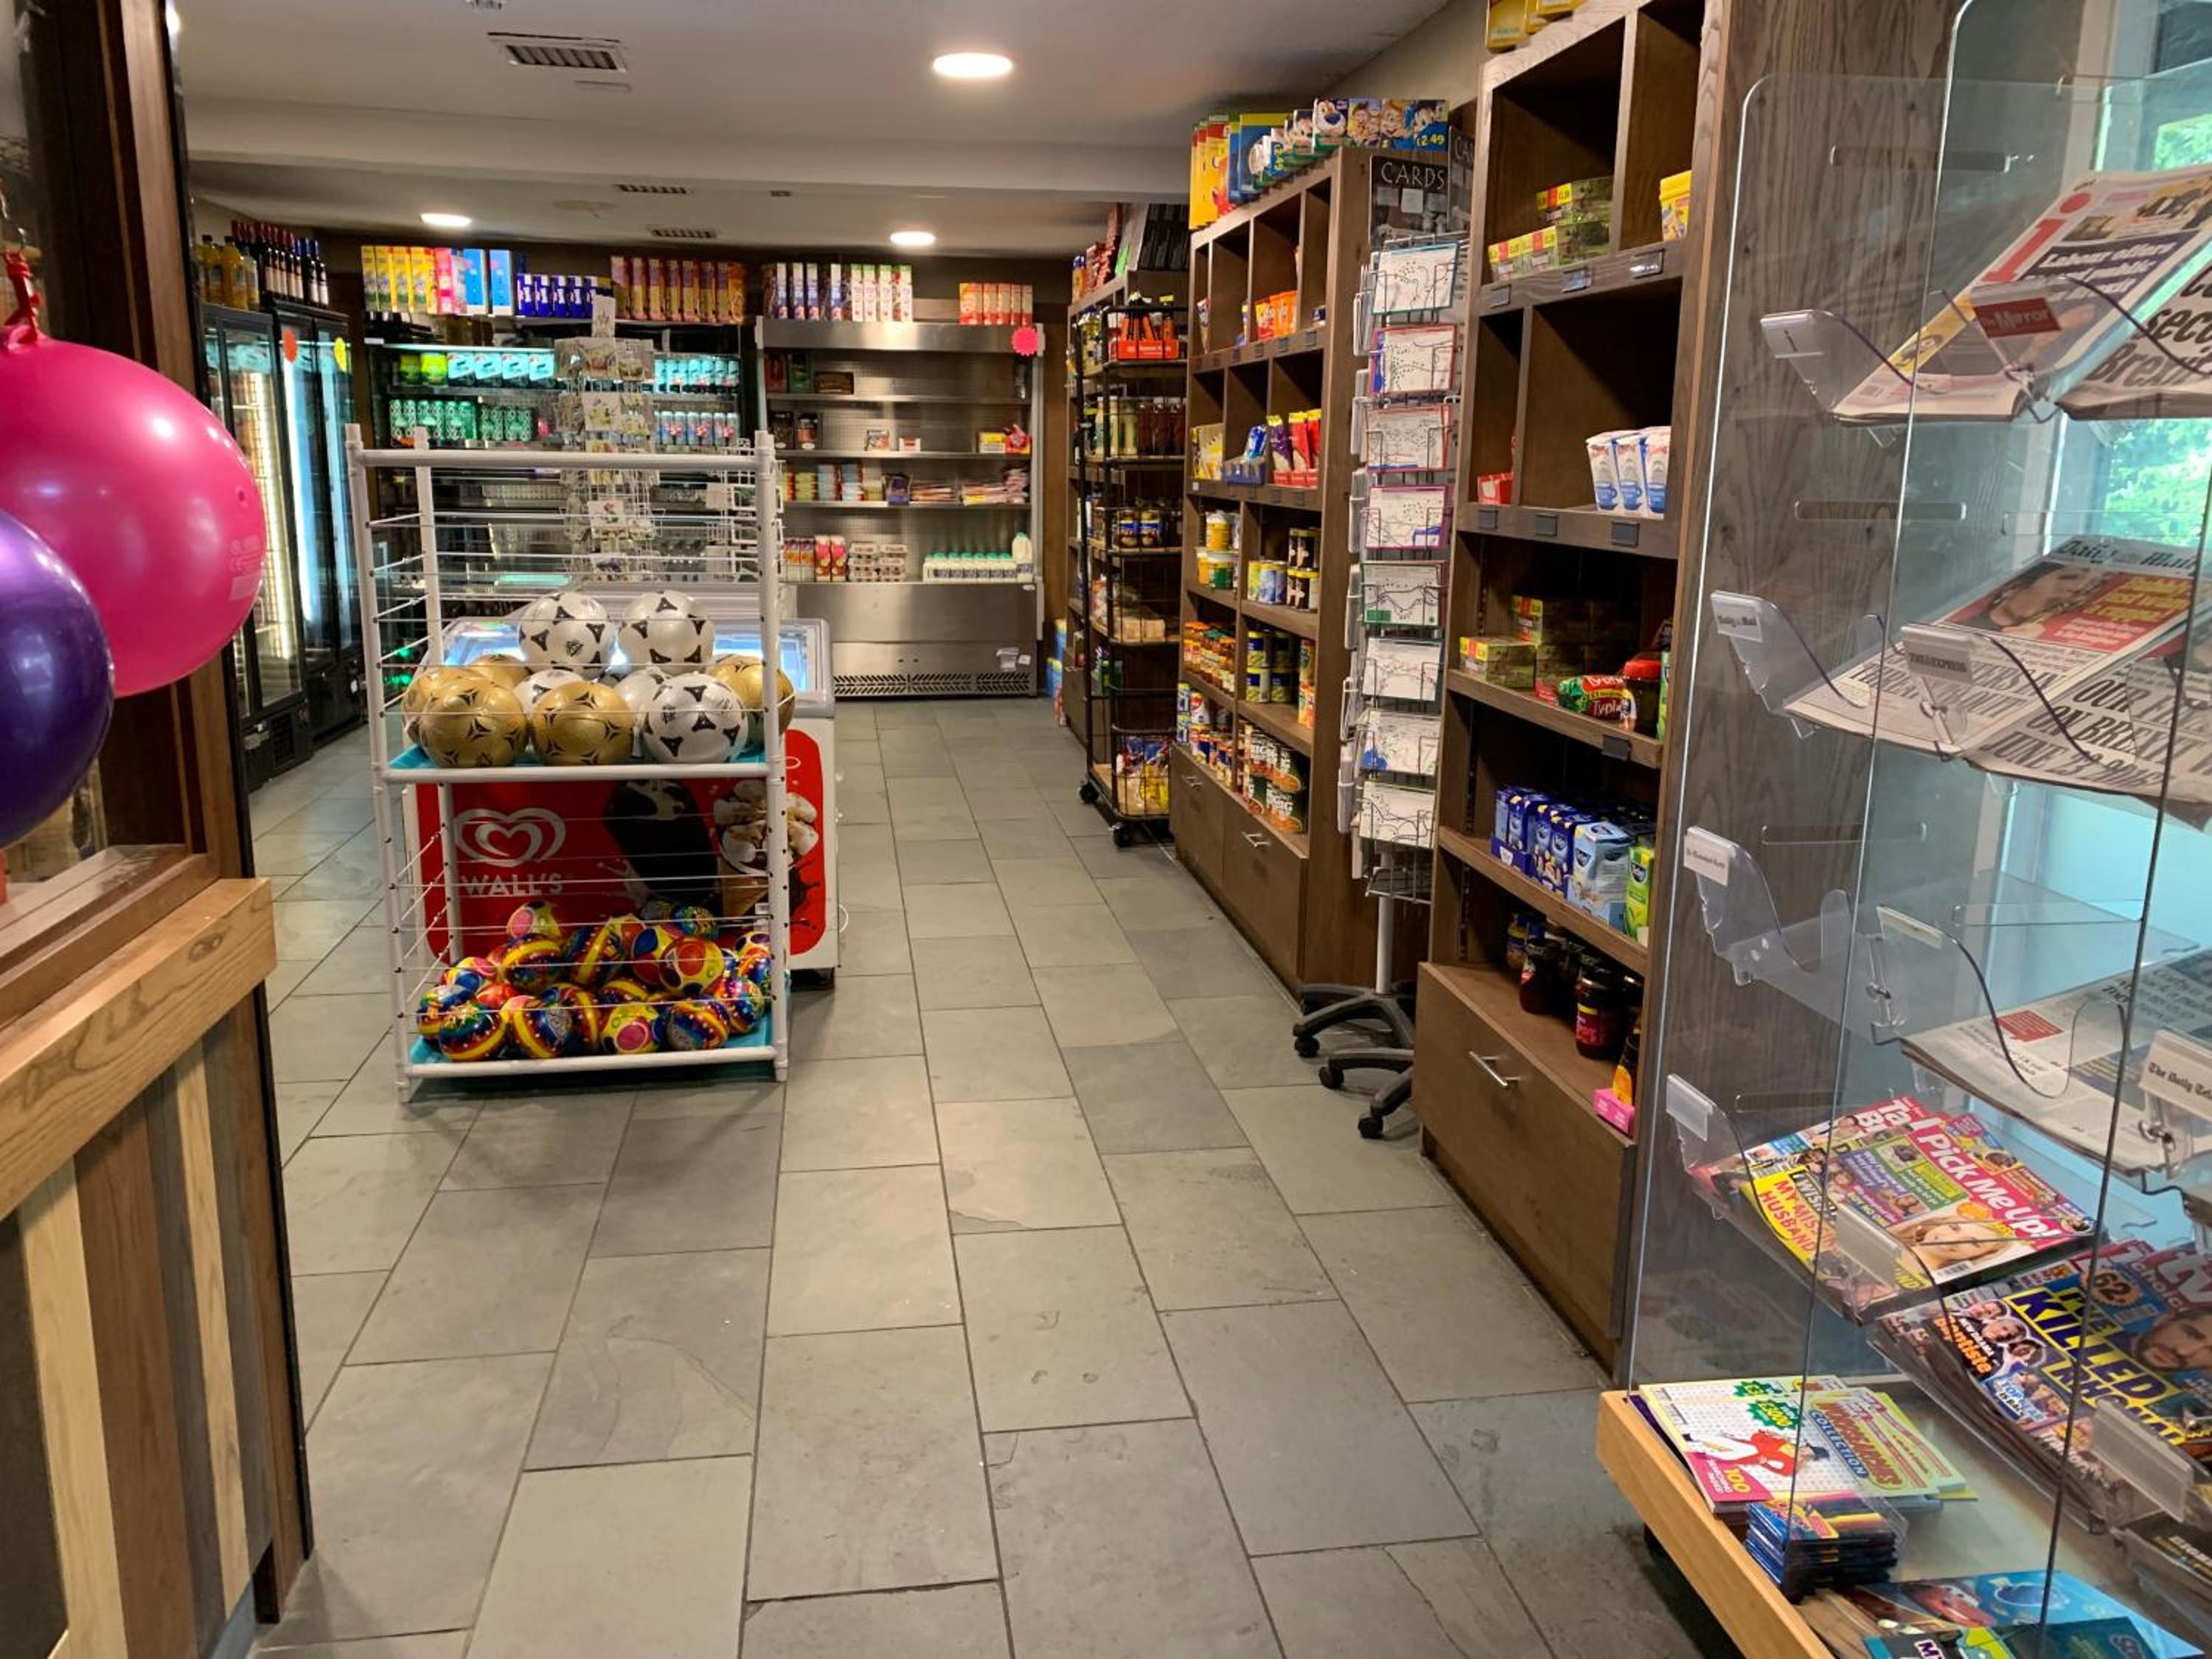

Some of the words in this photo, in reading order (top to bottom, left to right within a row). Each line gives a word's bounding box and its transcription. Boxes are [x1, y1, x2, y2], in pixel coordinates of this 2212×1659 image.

[1380, 161, 1445, 189] CARDS
[1993, 310, 2048, 330] Mirror
[1978, 731, 2067, 769] JUNE
[460, 872, 563, 897] WALL'S
[1773, 1180, 1800, 1202] MY
[1918, 1133, 1983, 1181] Pick
[1964, 1178, 2017, 1210] Me
[2004, 1206, 2065, 1240] Up!
[1759, 1190, 1817, 1251] HUSBAND
[2011, 1289, 2172, 1400] KILLED
[1812, 1411, 1866, 1475] COLLECTION
[1725, 1467, 1752, 1494] 100
